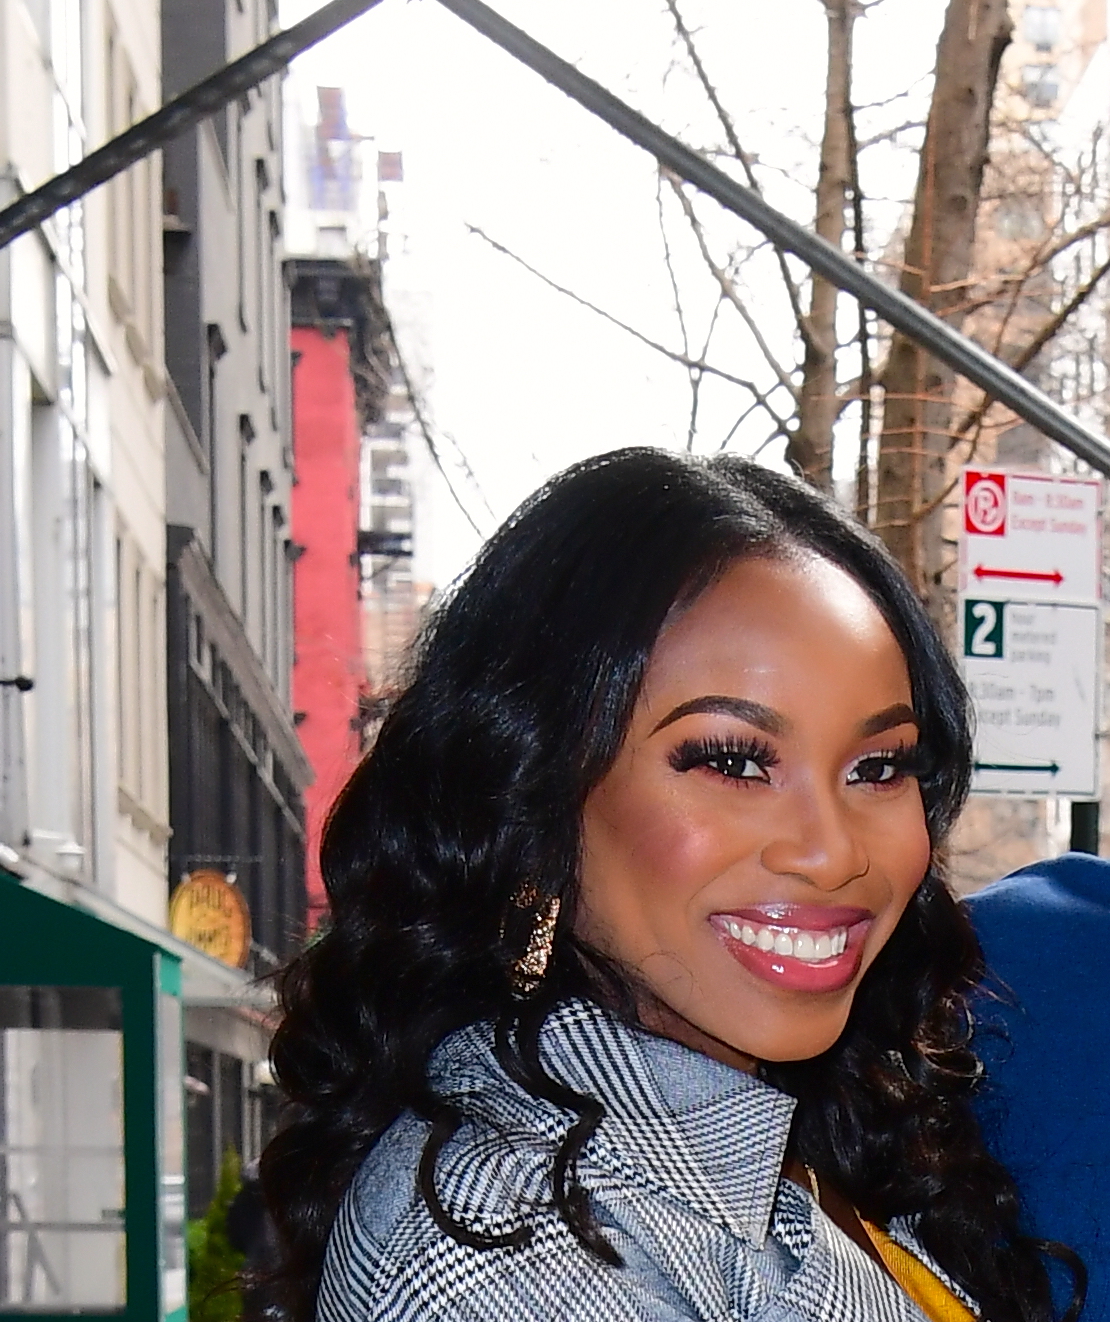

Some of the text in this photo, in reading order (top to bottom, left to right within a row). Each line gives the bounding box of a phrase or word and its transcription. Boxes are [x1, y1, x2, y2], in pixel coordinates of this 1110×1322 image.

[1051, 518, 1087, 535] Sunday
[971, 602, 997, 655] 2
[1016, 708, 1061, 728] Sunday
